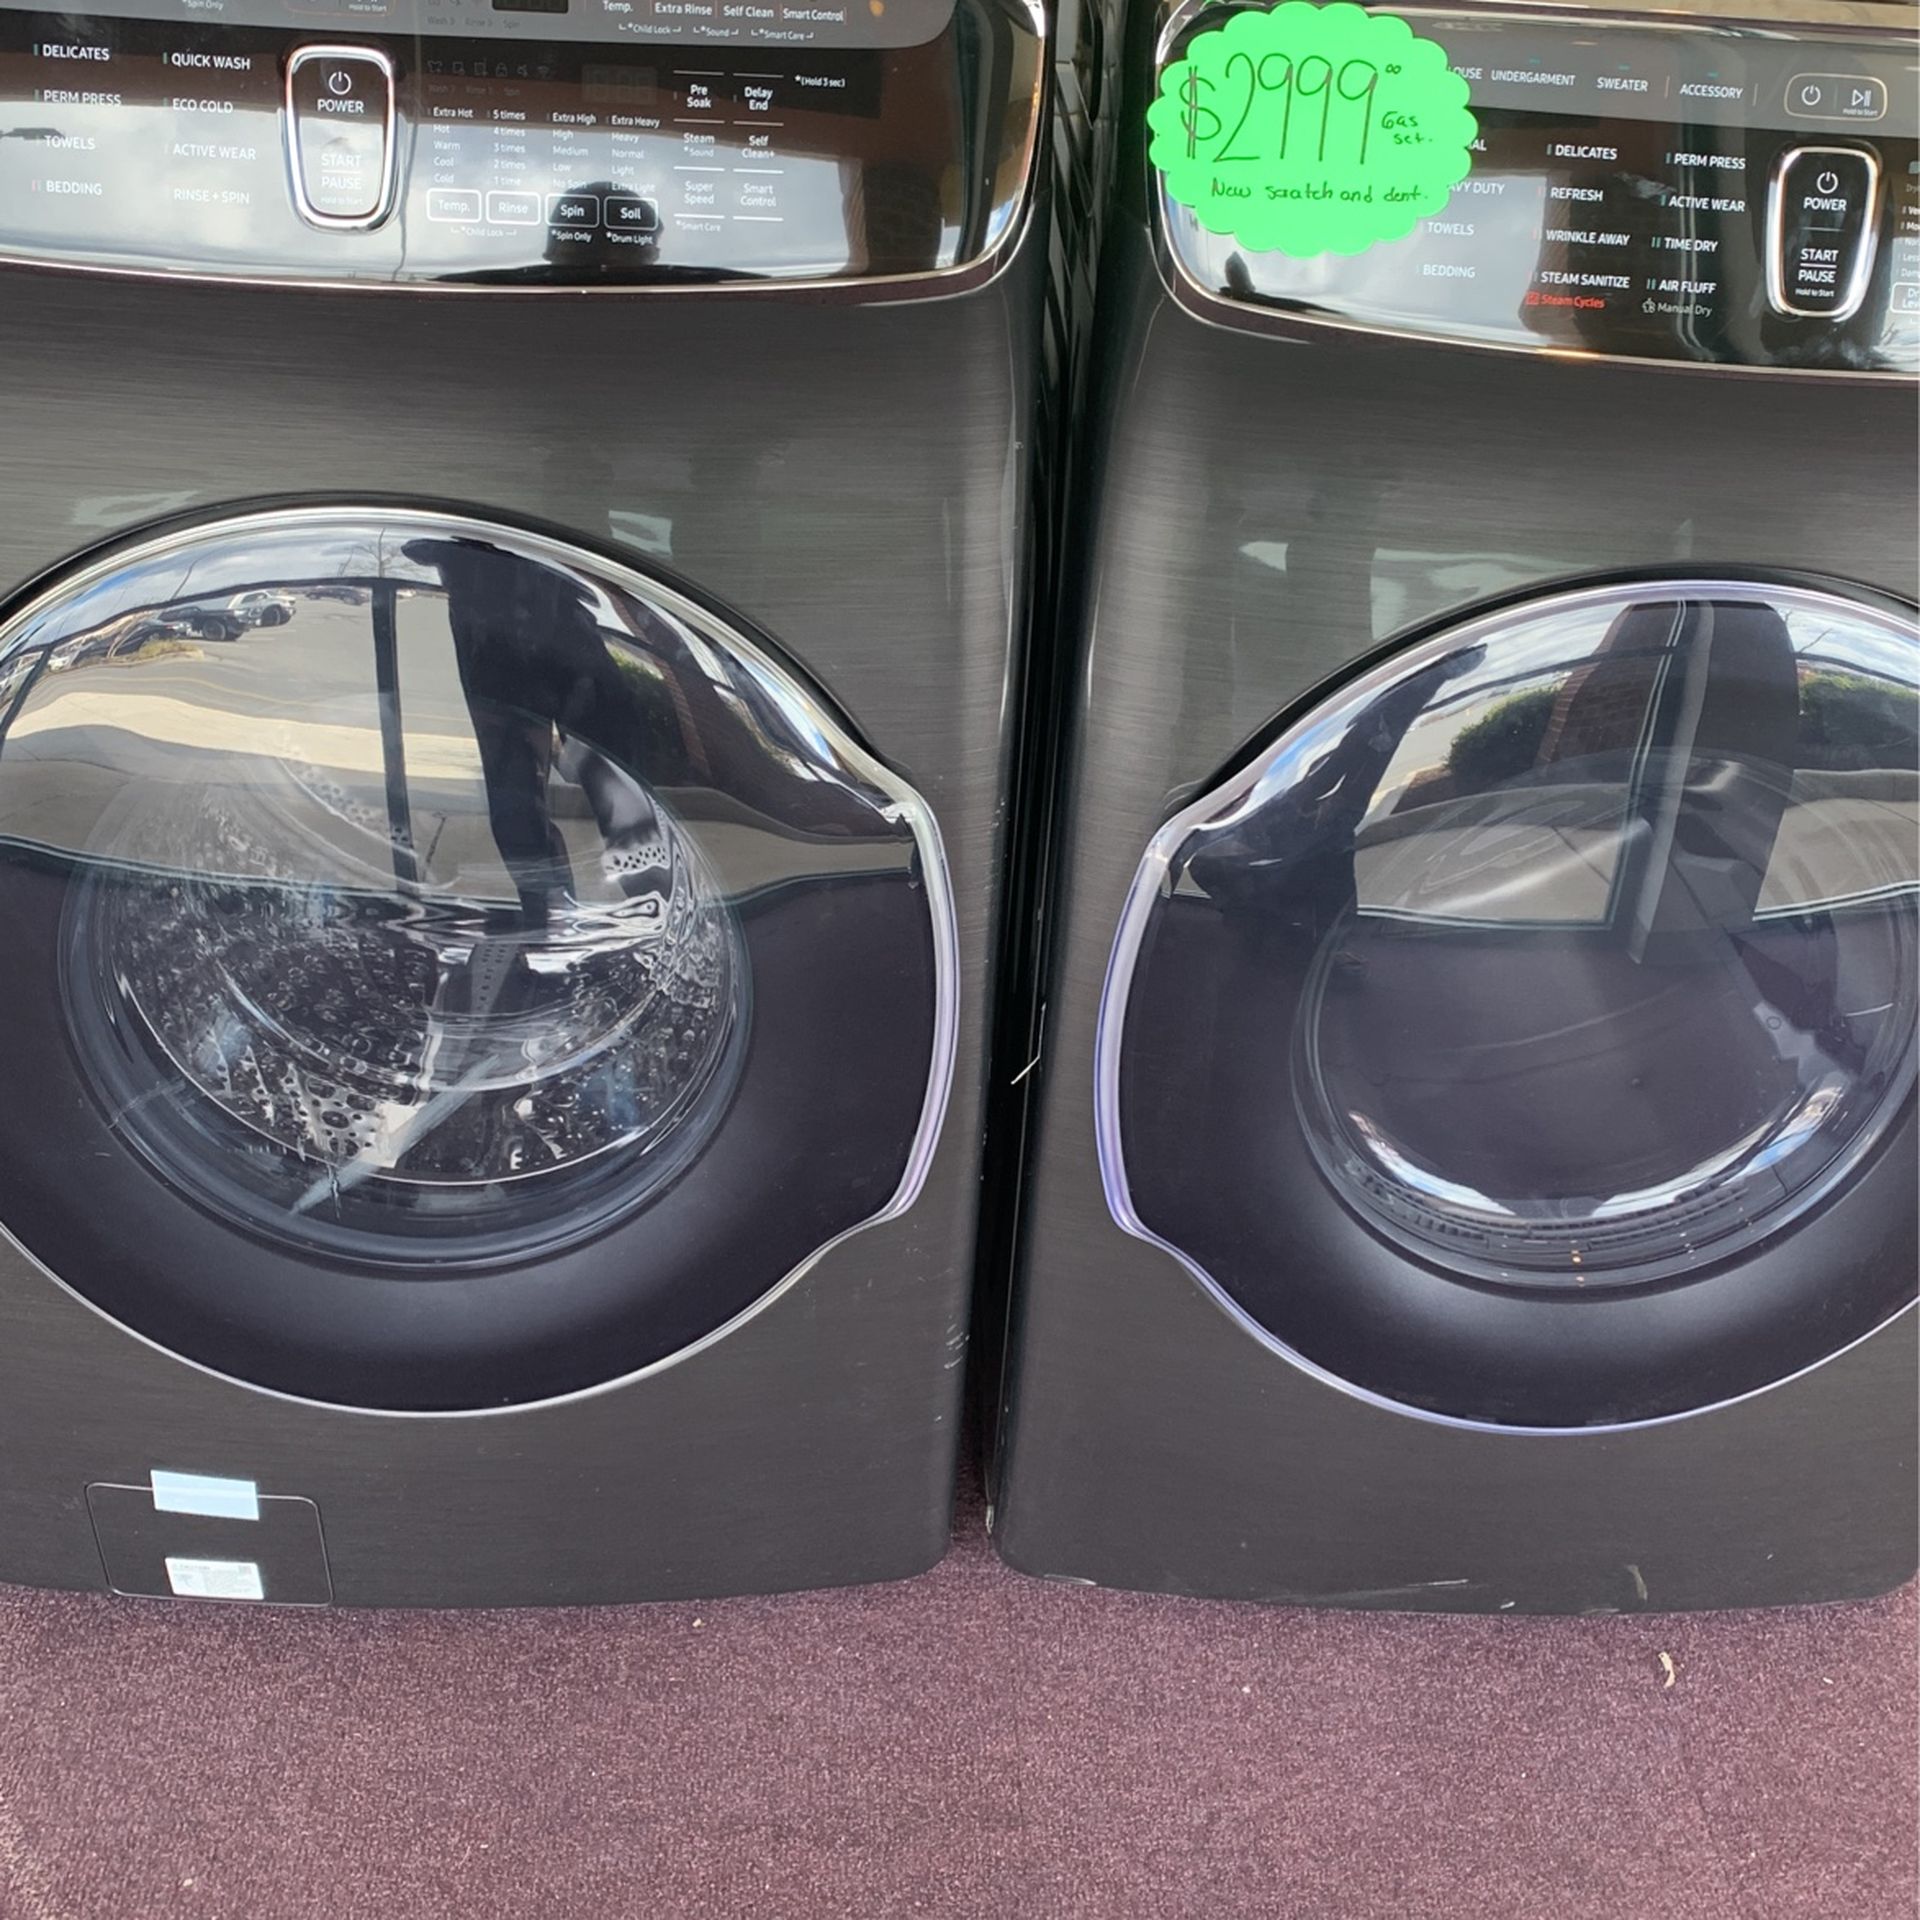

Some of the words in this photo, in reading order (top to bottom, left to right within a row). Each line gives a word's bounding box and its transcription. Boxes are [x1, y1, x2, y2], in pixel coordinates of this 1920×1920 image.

[655, 2, 683, 14] Extra
[685, 4, 712, 16] Rinse
[724, 4, 744, 16] Self
[745, 7, 774, 18] Clean
[784, 8, 809, 19] Smart
[811, 10, 844, 22] Control
[654, 25, 671, 35] Lock
[788, 31, 805, 41] Care
[43, 44, 110, 61] DELICATES
[171, 52, 210, 67] QUICK
[213, 55, 251, 70] WASH
[823, 77, 829, 87] 3
[1491, 70, 1576, 86] UNDERGARMENT
[1597, 77, 1649, 92] SWEATER
[690, 84, 708, 95] Pre
[744, 86, 773, 100] Delay
[1680, 83, 1743, 100] ACCESSORY
[44, 90, 79, 104] PERM
[84, 92, 122, 107] PRESS
[686, 96, 712, 108] Soak
[749, 100, 768, 111] End
[173, 98, 197, 111] ECO
[200, 100, 233, 114] COLD
[317, 99, 364, 114] POWER
[433, 106, 456, 117] Extra
[457, 108, 474, 118] Hot
[1180, 52, 1378, 165] $2999
[493, 109, 500, 119] 5
[501, 109, 526, 120] times
[552, 112, 575, 123] Extra
[576, 114, 596, 126] High
[1381, 111, 1419, 130] Gas
[433, 124, 451, 134] Hot
[611, 115, 633, 126] Extra
[634, 117, 660, 129] Heavy
[493, 126, 500, 135] 4
[501, 127, 526, 137] times
[552, 129, 574, 141] High
[611, 132, 639, 144] Heavy
[683, 133, 715, 144] Steam
[45, 134, 95, 150] TOWELS
[433, 140, 461, 151] Warm
[493, 142, 500, 152] 3
[501, 143, 526, 153] times
[748, 135, 769, 146] Self
[173, 143, 216, 158] ACTIVE
[219, 147, 256, 160] WEAR
[552, 145, 589, 156] Medium
[611, 148, 645, 159] Normal
[741, 148, 775, 159] Clean+
[1555, 144, 1618, 160] DELICATES
[321, 153, 362, 167] START
[433, 156, 454, 167] Cool
[493, 159, 500, 169] 2
[501, 160, 526, 170] times
[1674, 152, 1706, 166] PERM
[1709, 156, 1746, 170] PRESS
[552, 163, 571, 172] Low
[611, 165, 635, 176] Light
[322, 176, 362, 190] PAUSE
[434, 173, 454, 184] Cold
[494, 175, 499, 185] 1
[501, 176, 521, 186] time
[46, 180, 103, 195] BEDDING
[611, 181, 633, 192] Extra
[634, 183, 656, 194] Light
[685, 180, 713, 192] Super
[743, 183, 774, 194] Smart
[1211, 177, 1251, 198] New
[1265, 181, 1334, 200] scratch
[1340, 185, 1374, 203] and
[1473, 182, 1505, 195] DUTY
[174, 188, 211, 202] RINSE
[221, 191, 250, 205] SPIN
[684, 193, 715, 205] Speed
[740, 195, 777, 207] Control
[1551, 187, 1603, 201] REFRESH
[438, 198, 471, 214] Temp.
[498, 202, 529, 214] Rinse
[1669, 195, 1709, 209] ACTIVE
[1711, 199, 1745, 212] WEAR
[1803, 197, 1847, 211] POWER
[560, 204, 585, 218] Spin
[620, 207, 641, 220] Soil
[487, 227, 504, 237] Lock
[705, 222, 721, 232] Care
[1427, 221, 1474, 235] TOWELS
[574, 232, 592, 243] Only
[632, 235, 653, 246] Light
[1546, 229, 1597, 244] WRINKLE
[1598, 232, 1630, 246] AWAY
[1664, 237, 1692, 250] TIME
[1693, 239, 1718, 252] DRY
[1800, 248, 1839, 262] START
[1423, 264, 1475, 278] BEDDING
[1798, 269, 1836, 283] PAUSE
[1541, 271, 1580, 285] STEAM
[1581, 274, 1630, 288] SANITIZE
[1658, 279, 1679, 291] AIR
[1680, 280, 1717, 294] FLUFF
[1795, 288, 1810, 296] Hold
[1811, 289, 1818, 297] to
[1818, 289, 1834, 297] Start
[1541, 294, 1572, 306] Steam
[1573, 295, 1605, 308] Cycles
[1658, 302, 1692, 314] Manual
[1694, 305, 1712, 317] Dry
